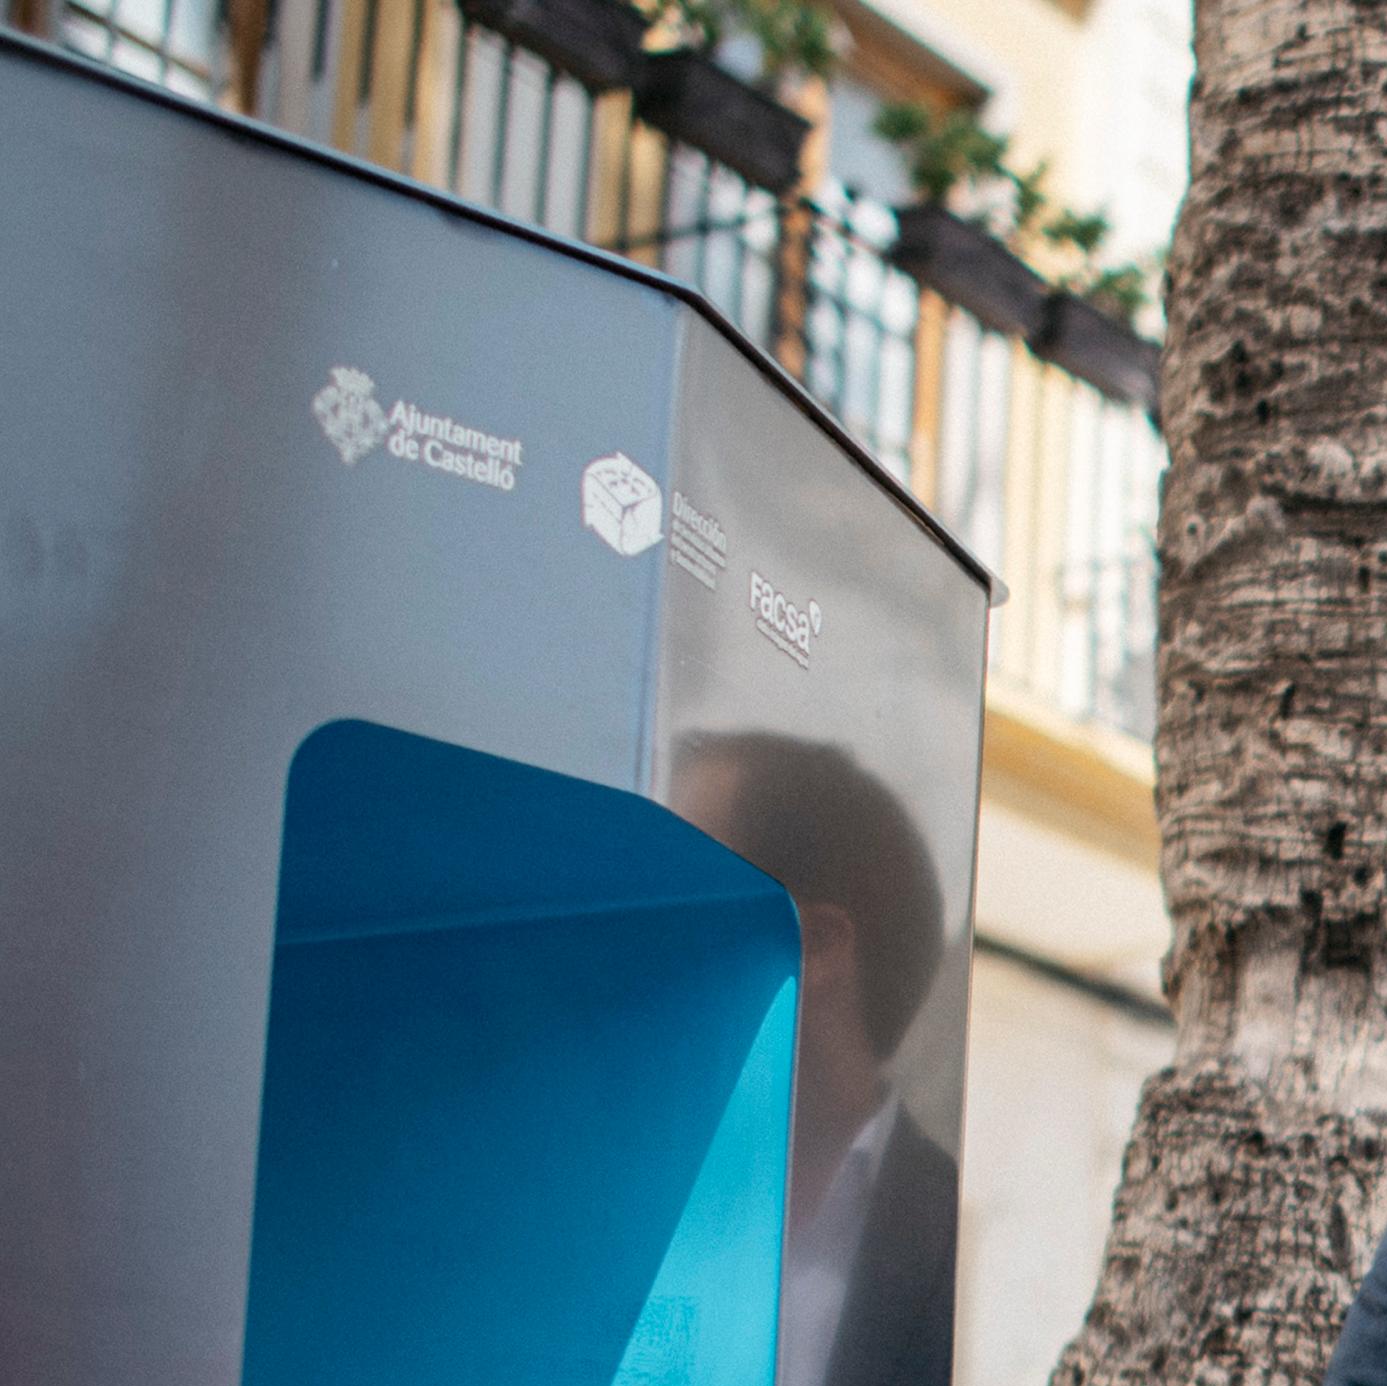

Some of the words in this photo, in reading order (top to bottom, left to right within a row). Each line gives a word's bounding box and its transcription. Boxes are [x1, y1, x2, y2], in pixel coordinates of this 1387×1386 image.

[388, 428, 419, 460] de
[425, 439, 515, 490] Castelló
[390, 400, 523, 466] Ajuntament
